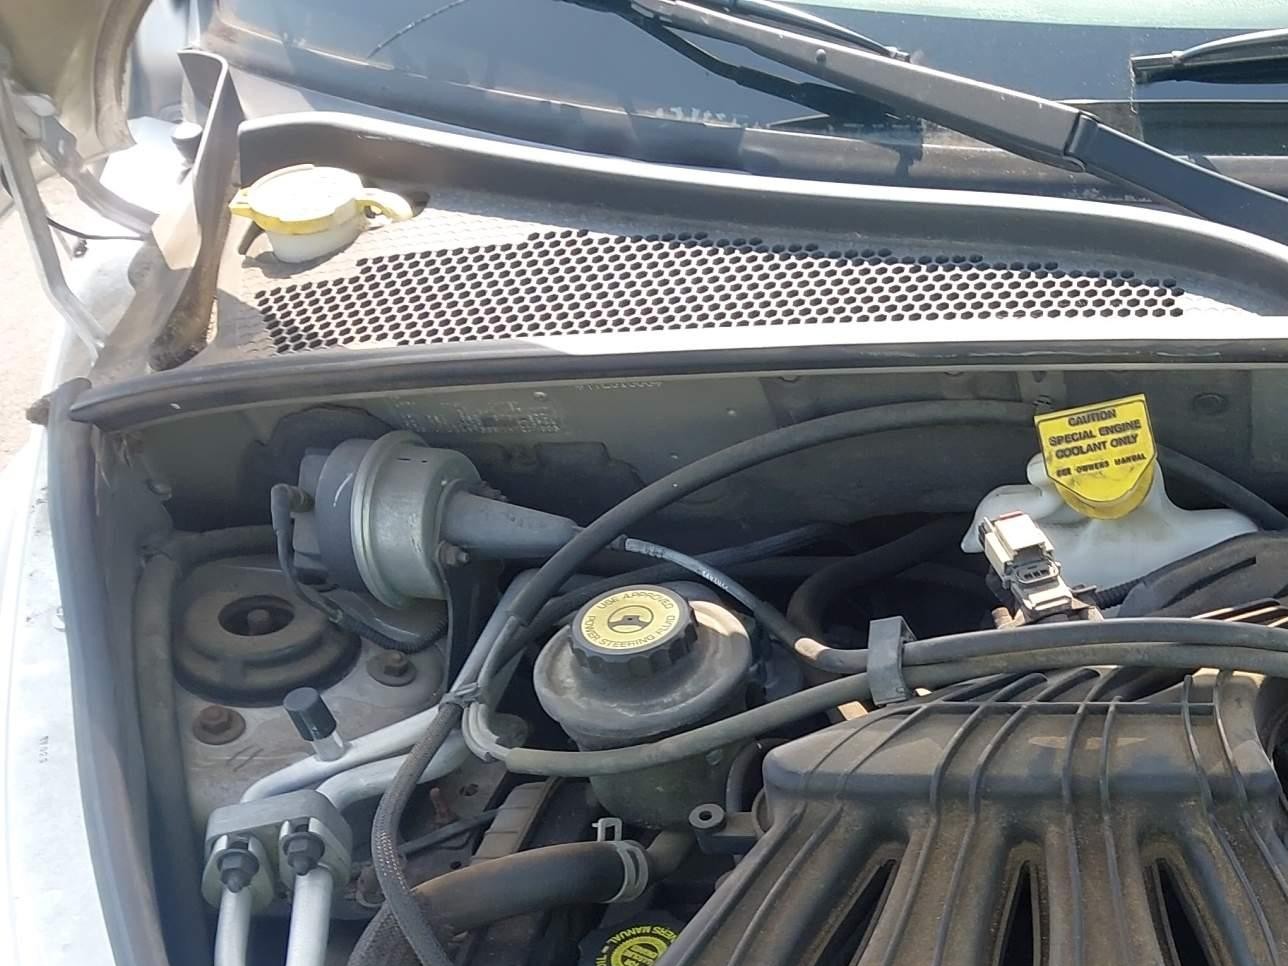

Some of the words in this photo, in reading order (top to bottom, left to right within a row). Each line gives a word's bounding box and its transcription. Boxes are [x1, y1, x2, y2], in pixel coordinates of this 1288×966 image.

[1068, 409, 1117, 427] CAUTION
[1048, 430, 1096, 447] SPECIAL
[1098, 419, 1141, 437] ENGINE
[1055, 441, 1108, 459] COOLANT
[1110, 434, 1138, 448] ONLY
[585, 615, 601, 641] POWER
[600, 634, 656, 648] STEERING
[607, 926, 651, 945] MANUAL
